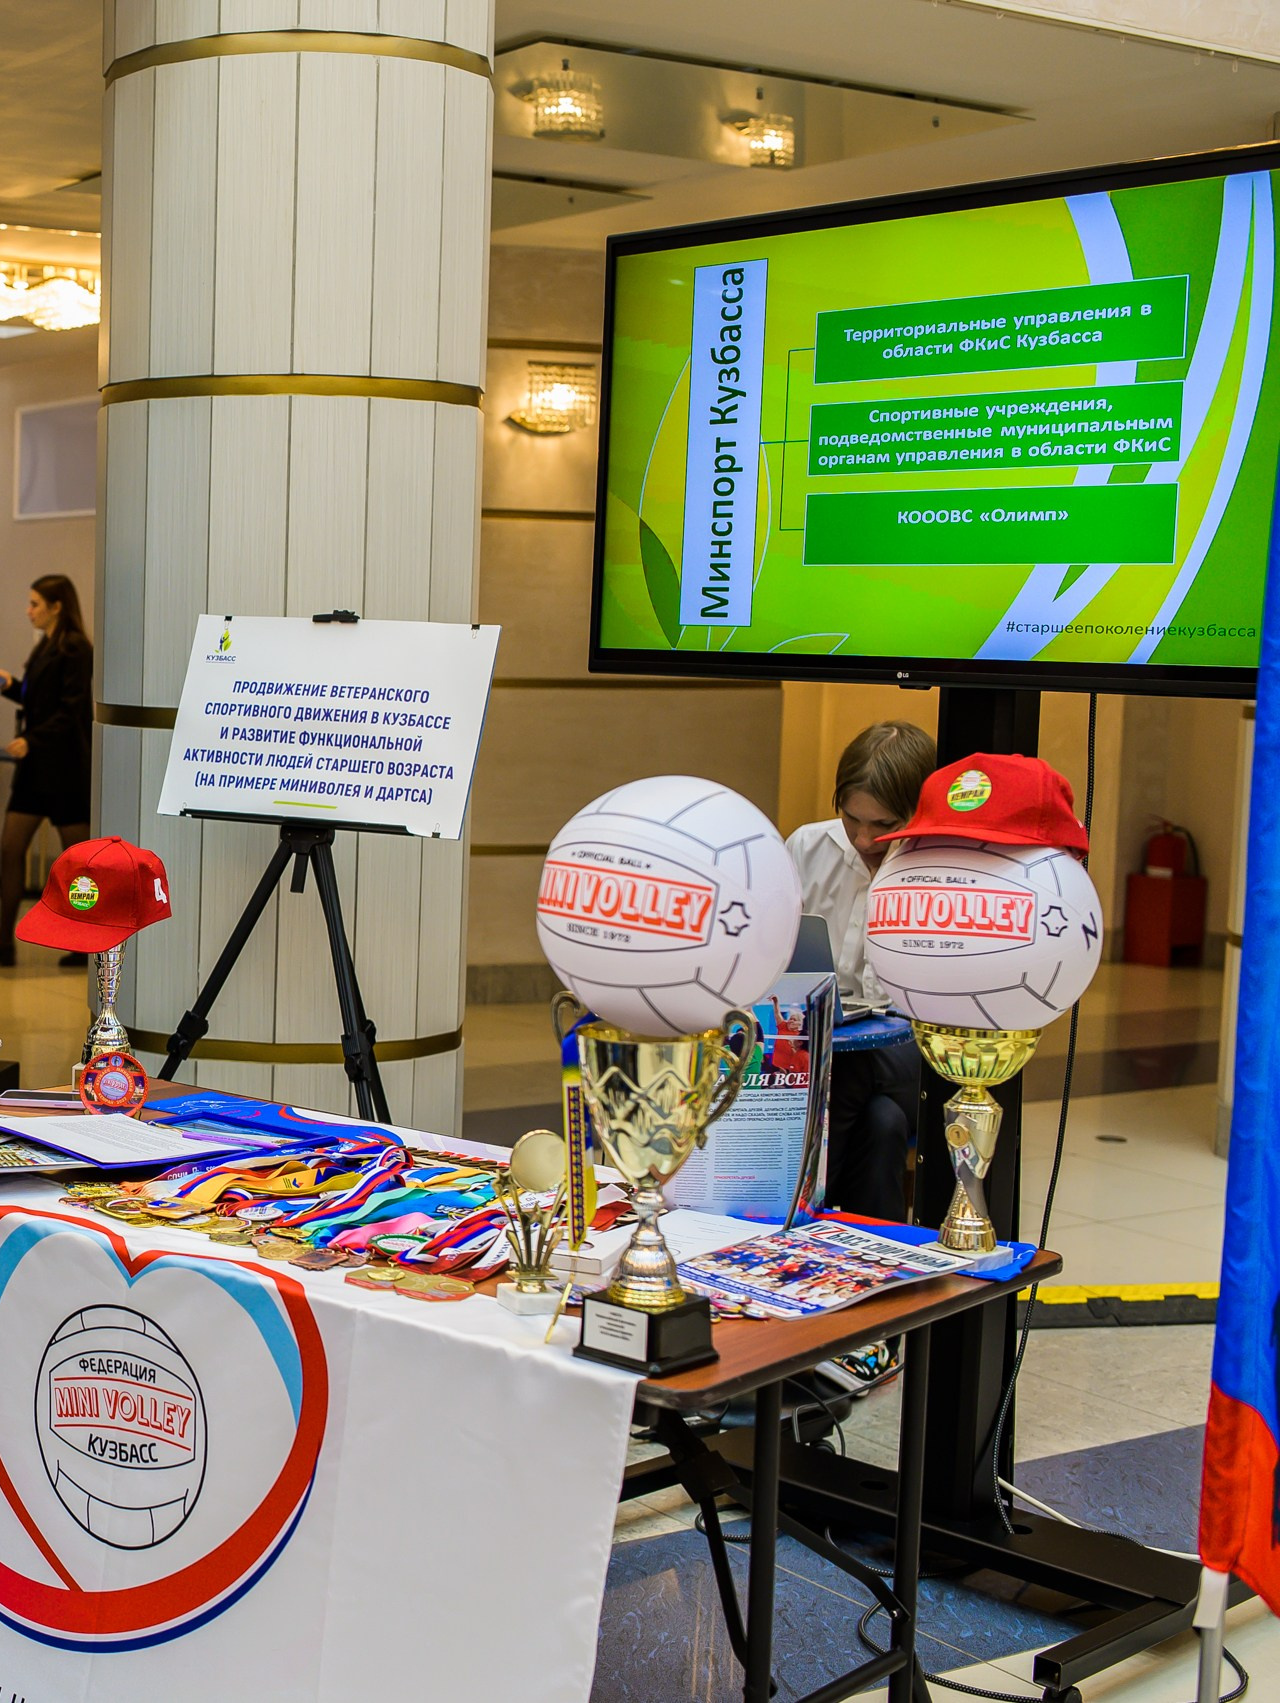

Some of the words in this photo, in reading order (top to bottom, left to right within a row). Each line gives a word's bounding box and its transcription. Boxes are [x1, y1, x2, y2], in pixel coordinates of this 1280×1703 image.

[844, 316, 1006, 343] Территориальные
[1014, 304, 1131, 330] управления
[1140, 303, 1152, 316] в
[709, 268, 747, 425] Кузбасса
[882, 342, 953, 360] области
[959, 336, 1010, 353] ФКиС
[1016, 329, 1103, 349] Кузбасса
[869, 404, 978, 427] Спортивные
[986, 399, 1113, 421] учреждения,
[819, 426, 992, 447] подведомственные
[1001, 417, 1173, 438] муниципальным
[818, 451, 890, 468] органам
[896, 446, 1003, 466] управления
[1012, 447, 1022, 458] в
[1029, 440, 1106, 457] области
[1114, 437, 1171, 452] ФКиС
[700, 437, 743, 617] Минспорт
[897, 509, 973, 525] КОООВС
[980, 509, 1069, 523] «Олимп»
[1006, 621, 1256, 638] #старшеепоколениекузбасса
[206, 654, 236, 662] КУЗБАСС
[232, 680, 327, 697] ПРОДВИЖЕНИЕ
[330, 685, 430, 704] ВЕТЕРАНСКОГО
[204, 702, 292, 720] СПОРТИВНОГО
[294, 707, 368, 725] ДВИЖЕНИЯ
[370, 711, 380, 724] В
[382, 712, 451, 730] КУЗБАССЕ
[220, 726, 229, 739] И
[231, 727, 296, 745] РАЗВИТИЕ
[298, 730, 423, 752] ФУНКЦИОНАЛЬНОЙ
[183, 749, 263, 767] АКТИВНОСТИ
[265, 752, 314, 770] ЛЮДЕЙ
[315, 757, 384, 775] СТАРШЕГО
[387, 763, 454, 780] ВОЗРАСТА
[195, 772, 216, 788] (НА
[218, 775, 276, 791] ПРИМЕРЕ
[278, 777, 361, 798] МИНИВОЛЕЯ
[364, 785, 373, 798] И
[375, 786, 433, 805] ДАРТСА)
[906, 875, 942, 883] OFFICIAL
[945, 876, 968, 884] BALL
[567, 922, 600, 937] SINCE
[902, 939, 934, 948] SINCE
[939, 941, 964, 949] 1972
[740, 1073, 771, 1087] ЛЯ
[79, 1358, 156, 1383] ФЕДЕРАЦИЯ
[54, 1387, 100, 1418] MINI
[102, 1388, 192, 1438] VOLLEY
[88, 1433, 158, 1463] КУЗБАСС
